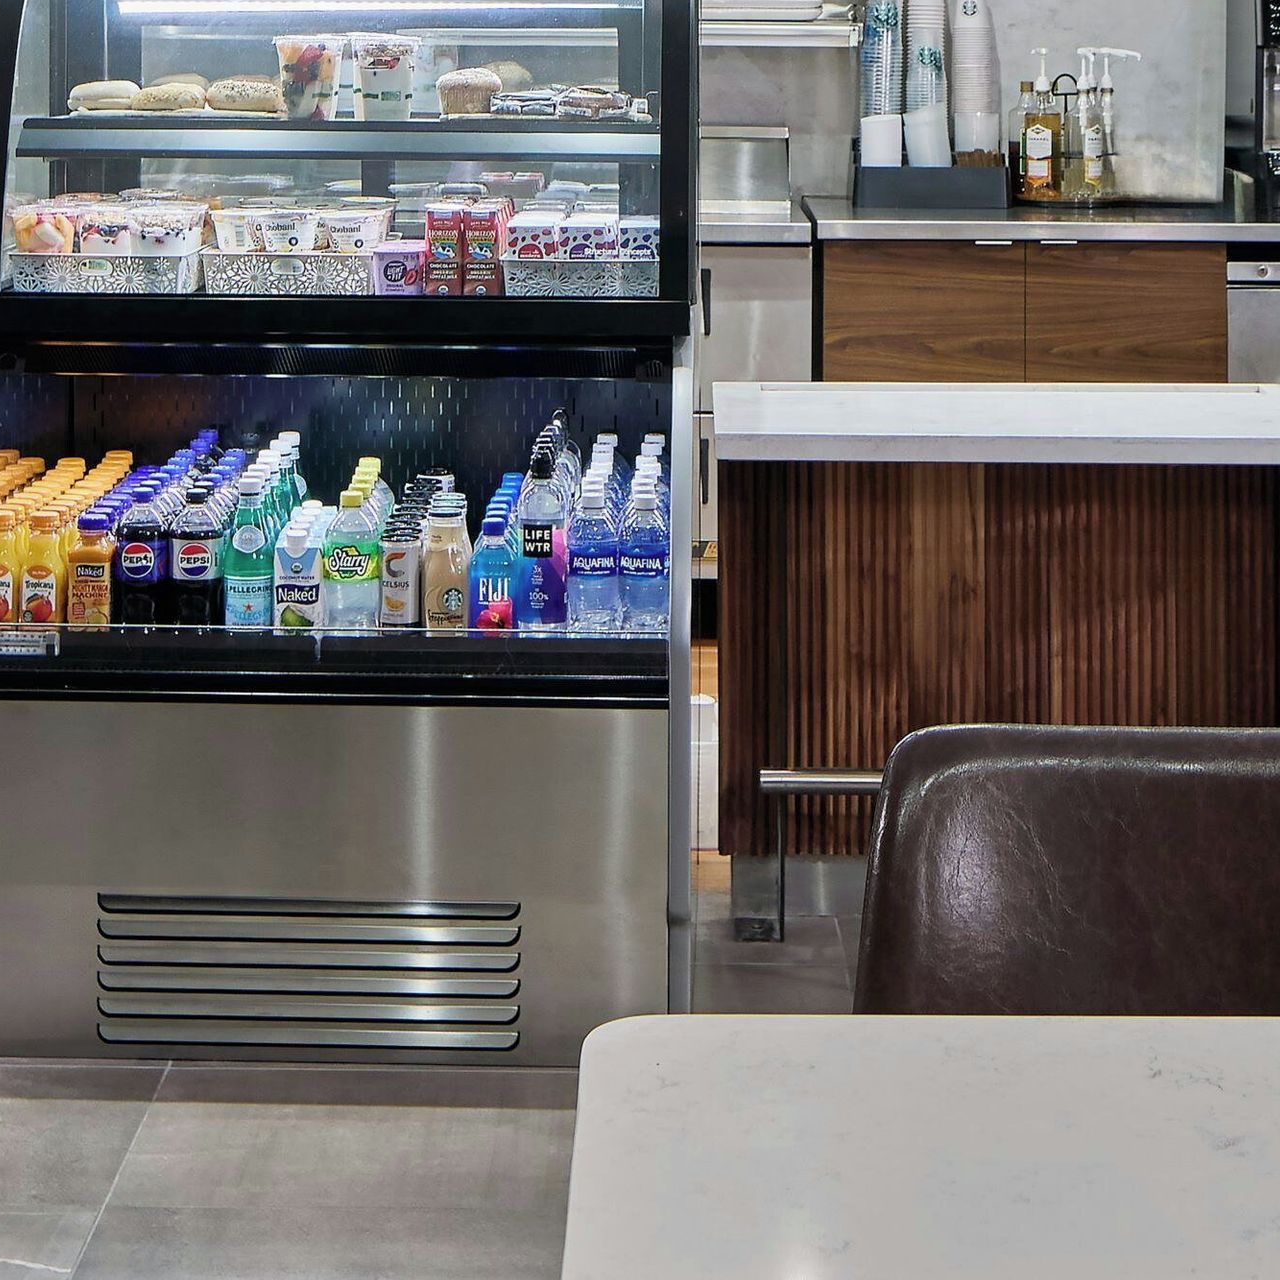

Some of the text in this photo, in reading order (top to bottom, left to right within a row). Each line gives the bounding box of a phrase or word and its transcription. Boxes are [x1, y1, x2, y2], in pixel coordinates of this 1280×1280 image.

[428, 229, 458, 238] HORIZON
[465, 229, 496, 238] HORIZON
[525, 529, 550, 540] LIFE
[525, 542, 550, 552] WTR
[123, 554, 152, 564] PEPSI
[180, 552, 210, 564] PEPSI
[329, 548, 370, 573] Starry
[573, 556, 615, 569] AQUAFINA
[620, 556, 662, 569] AQUAFINA
[77, 566, 103, 577] Naked
[25, 580, 54, 590] Tropicana
[382, 580, 410, 588] CELSIUS
[479, 578, 509, 601] FIJI
[529, 592, 549, 601] 100%
